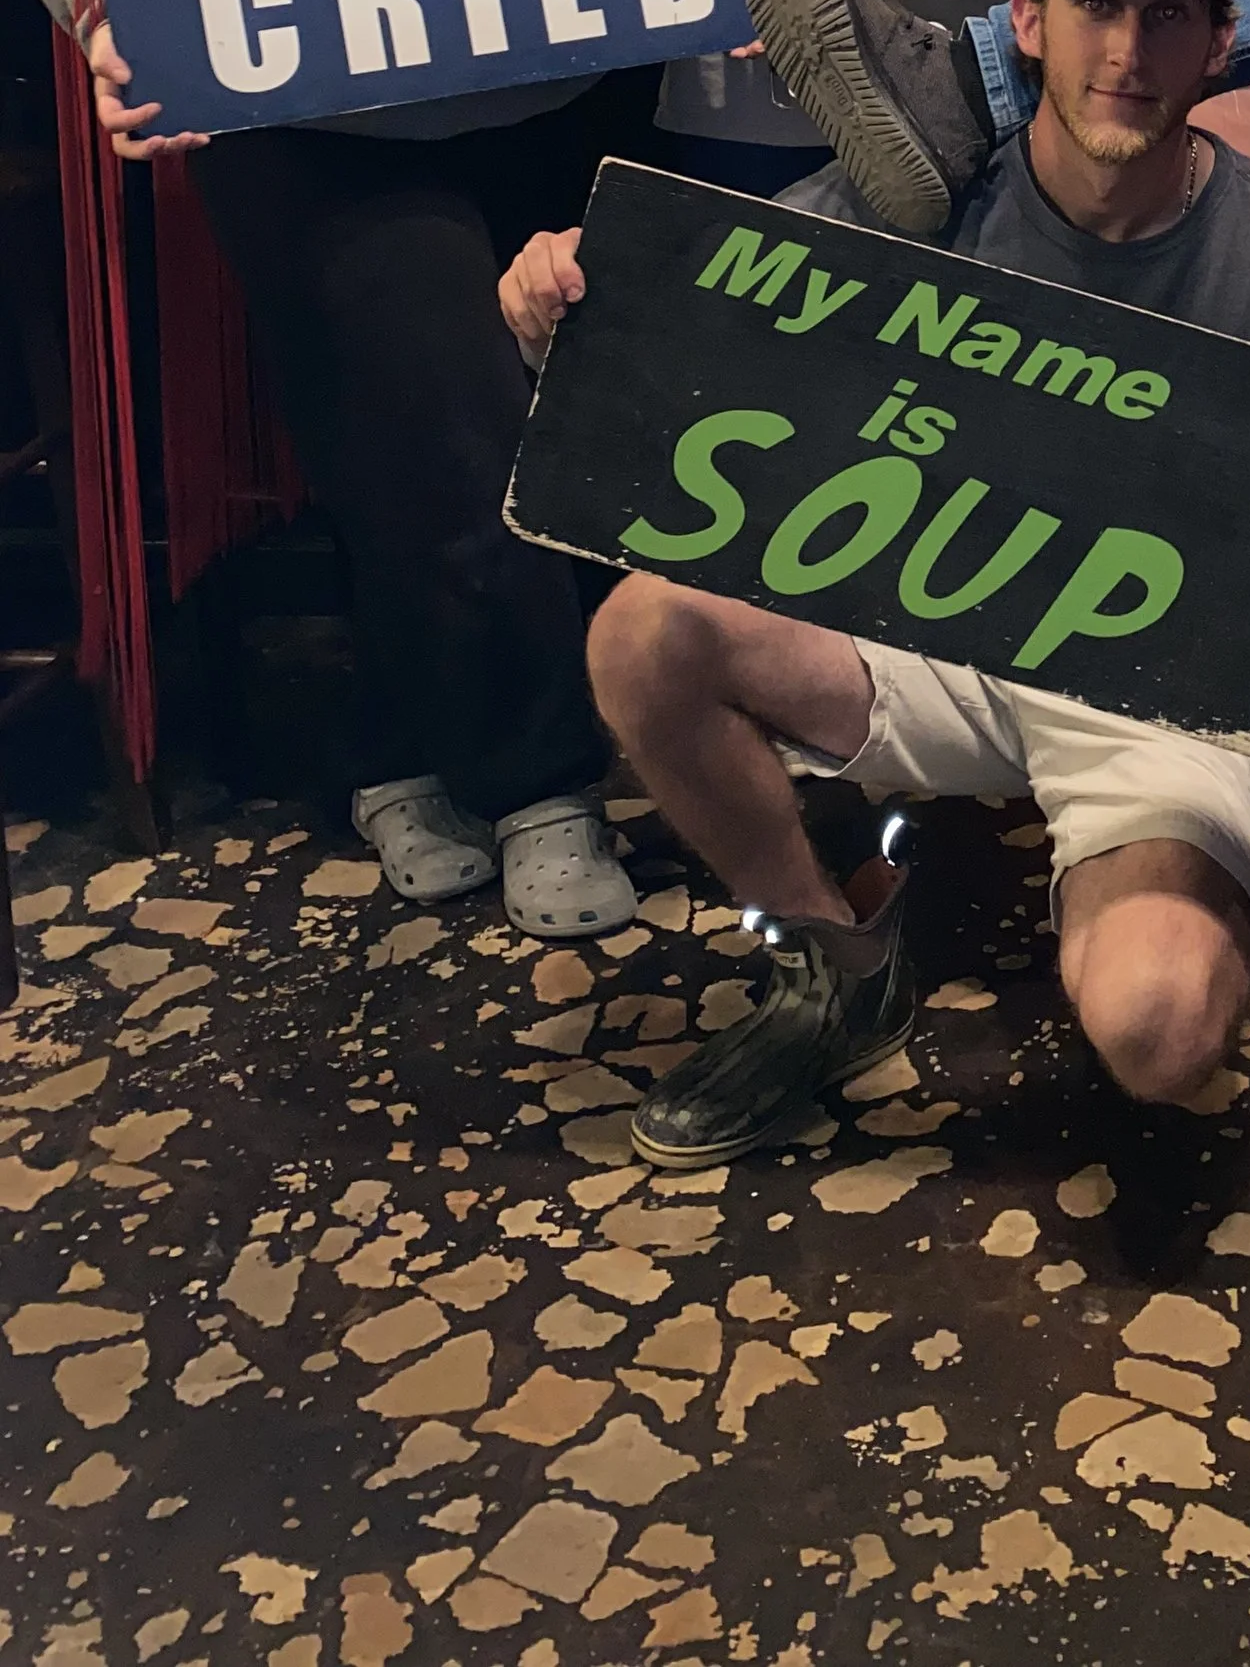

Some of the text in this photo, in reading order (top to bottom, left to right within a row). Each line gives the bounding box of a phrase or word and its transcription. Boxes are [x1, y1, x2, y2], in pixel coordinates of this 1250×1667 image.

[695, 226, 1172, 421] My Name
[857, 379, 957, 456] is
[618, 409, 1185, 669] SOUP
